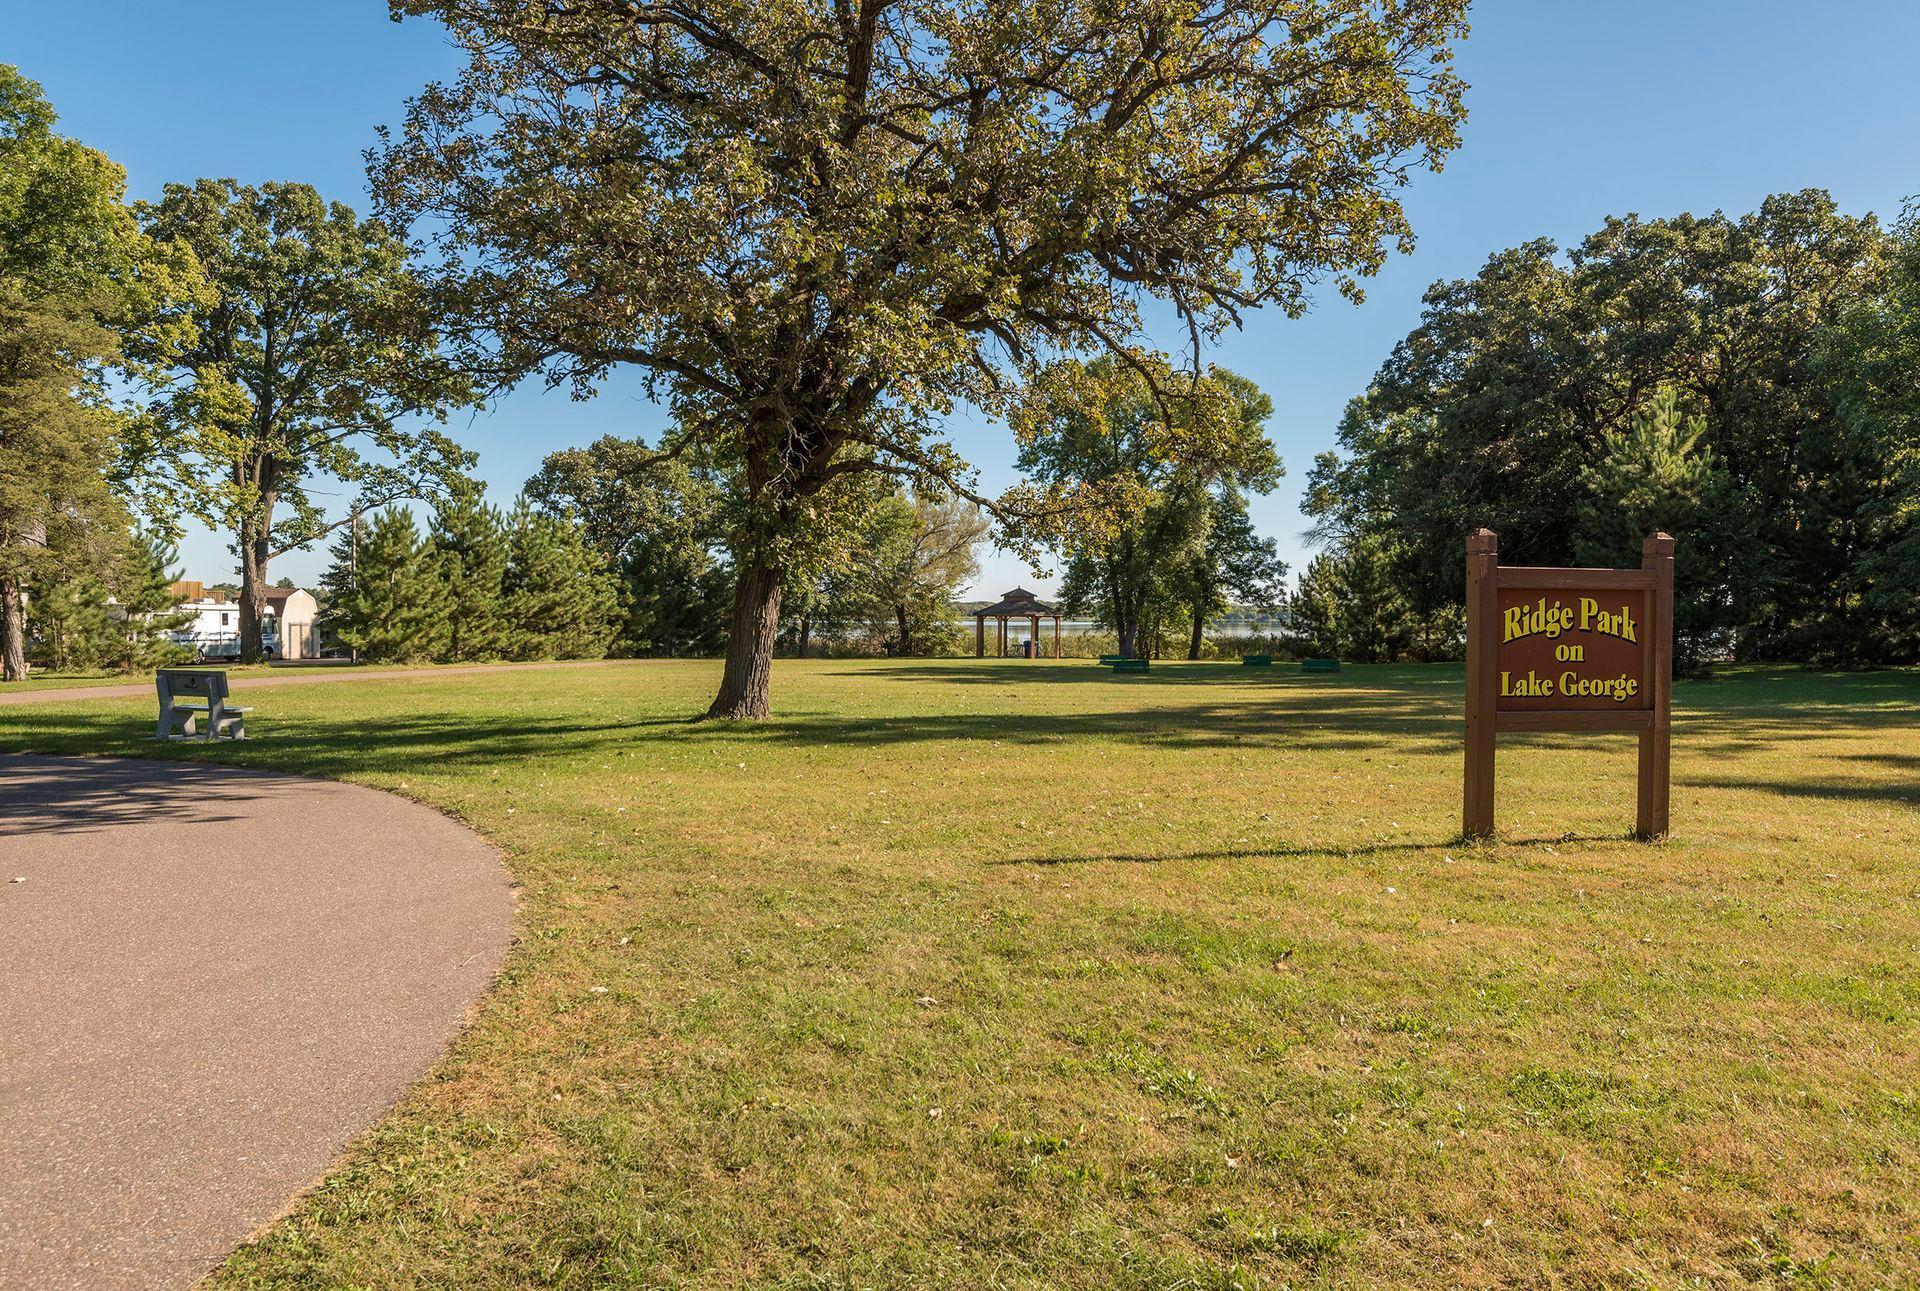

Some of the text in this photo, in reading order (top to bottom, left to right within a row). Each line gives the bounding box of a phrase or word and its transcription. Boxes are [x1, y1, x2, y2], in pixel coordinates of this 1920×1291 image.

[1502, 597, 1637, 643] Ridge Park
[1555, 644, 1584, 662] on
[1500, 670, 1638, 701] Lake George
